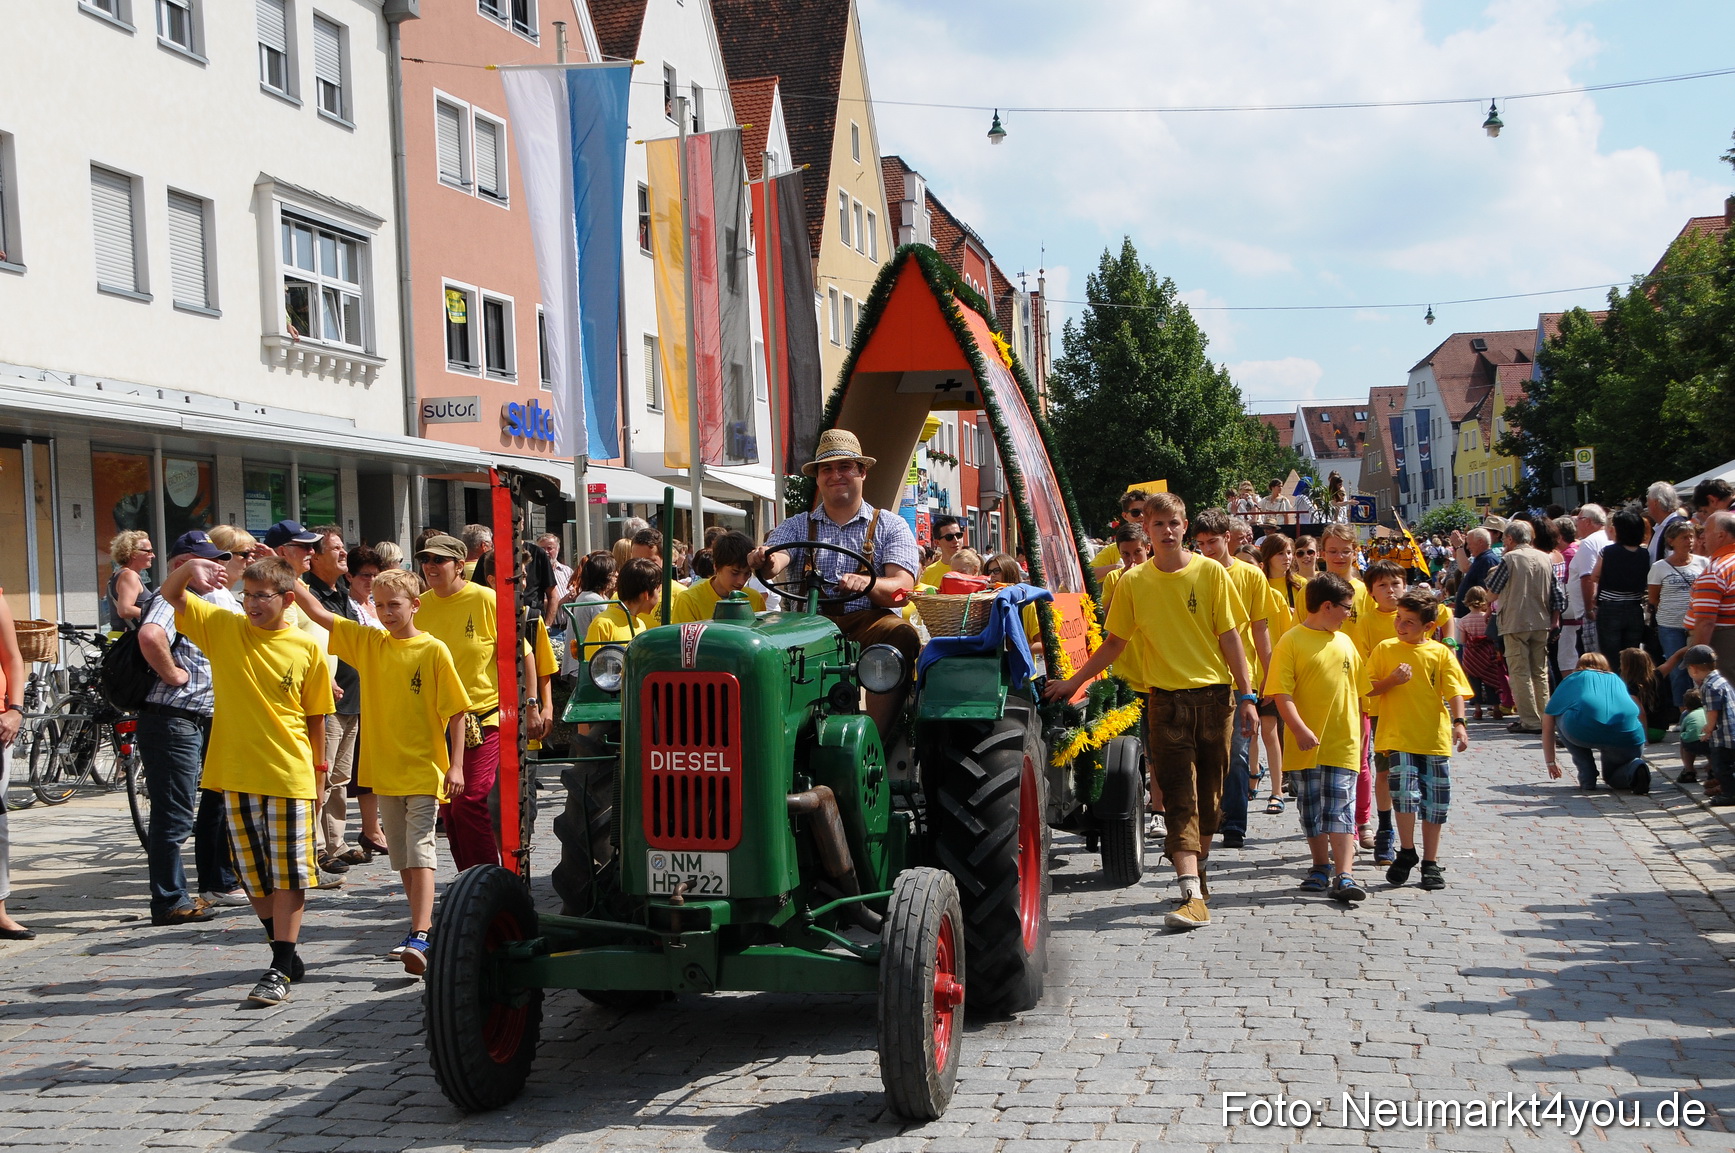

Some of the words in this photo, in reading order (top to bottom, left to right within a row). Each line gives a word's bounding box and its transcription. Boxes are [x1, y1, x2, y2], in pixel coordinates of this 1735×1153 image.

[423, 401, 476, 418] sutor.
[503, 398, 554, 441] suto
[650, 751, 731, 772] DIESEL
[671, 853, 702, 873] NM
[653, 873, 681, 893] HR
